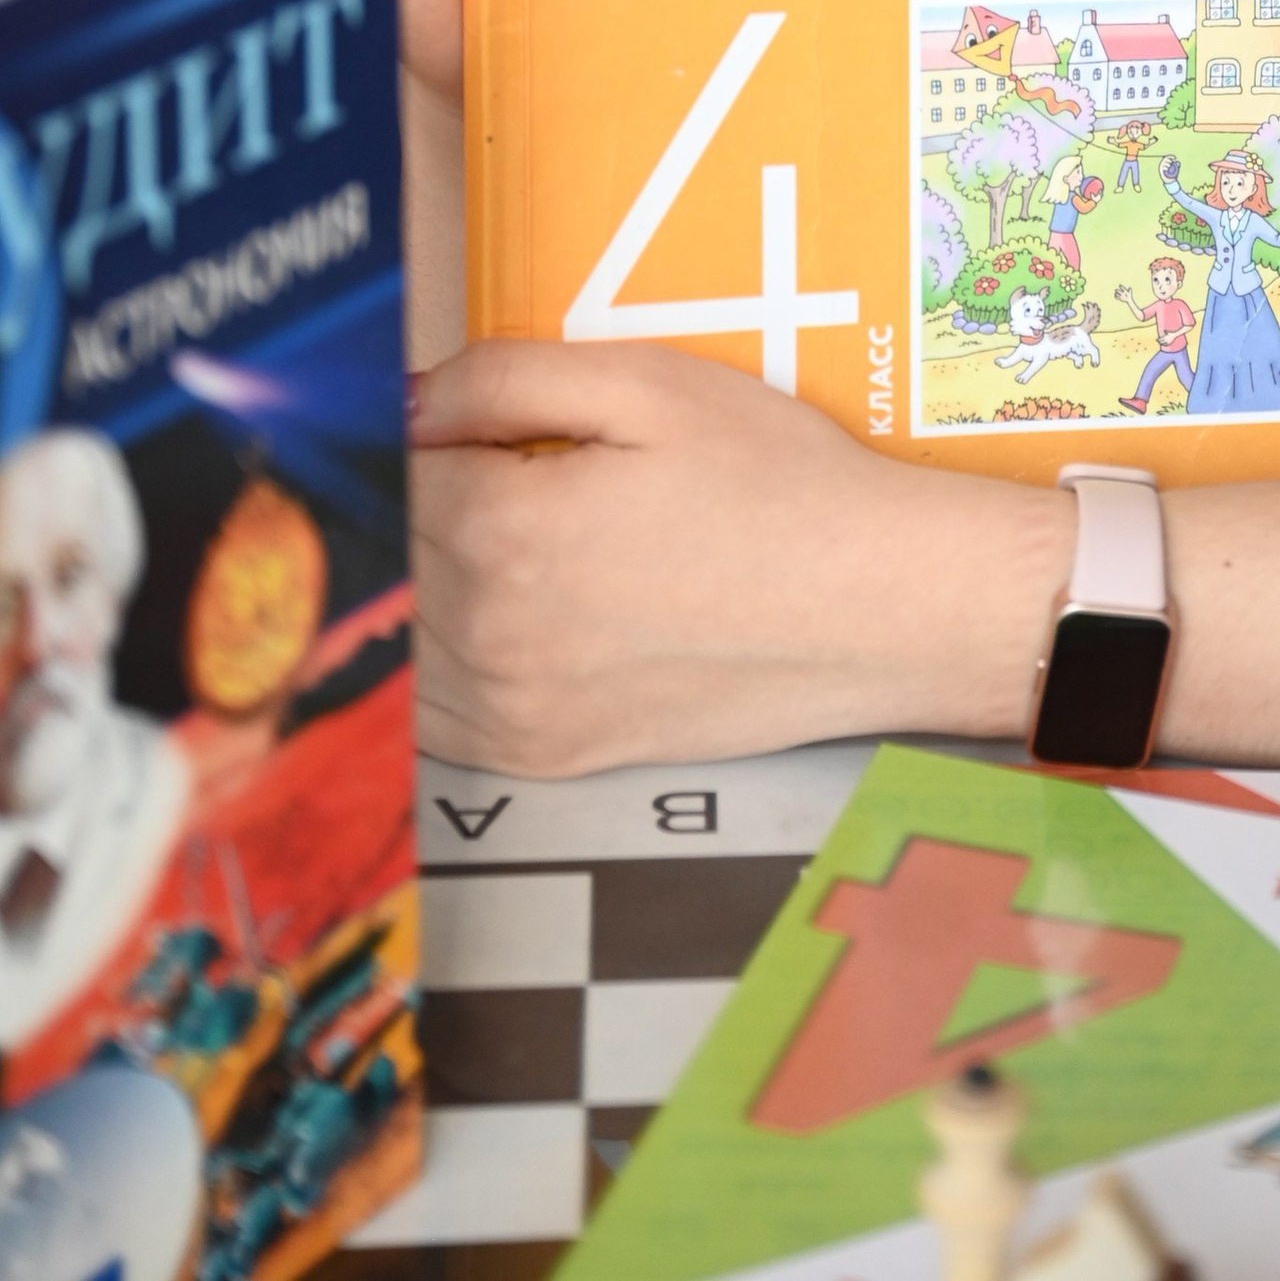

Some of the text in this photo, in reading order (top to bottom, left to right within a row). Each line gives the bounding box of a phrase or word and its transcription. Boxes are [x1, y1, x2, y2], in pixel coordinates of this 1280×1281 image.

[562, 12, 859, 397] 4
[868, 324, 893, 435] КЛАСС
[432, 794, 513, 840] A
[652, 791, 717, 835] B
[747, 834, 1184, 1136] 4
